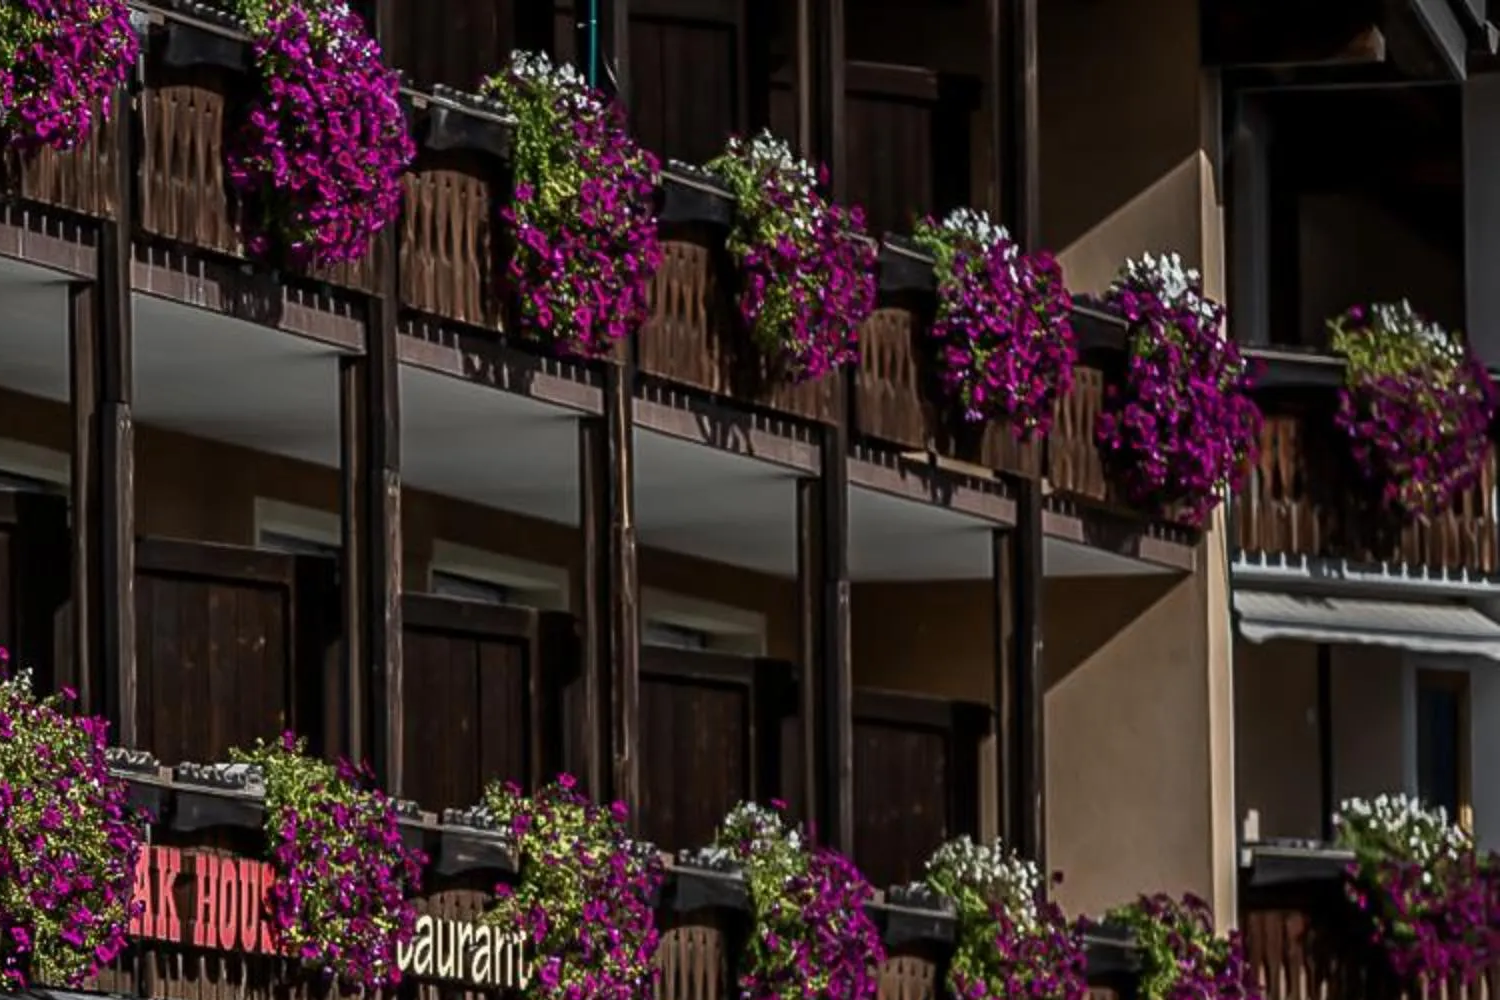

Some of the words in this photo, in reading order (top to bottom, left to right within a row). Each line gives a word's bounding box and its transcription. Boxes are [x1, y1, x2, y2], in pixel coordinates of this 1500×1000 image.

[129, 842, 181, 943] AK
[194, 852, 288, 956] HOUS
[397, 914, 533, 991] aurant
